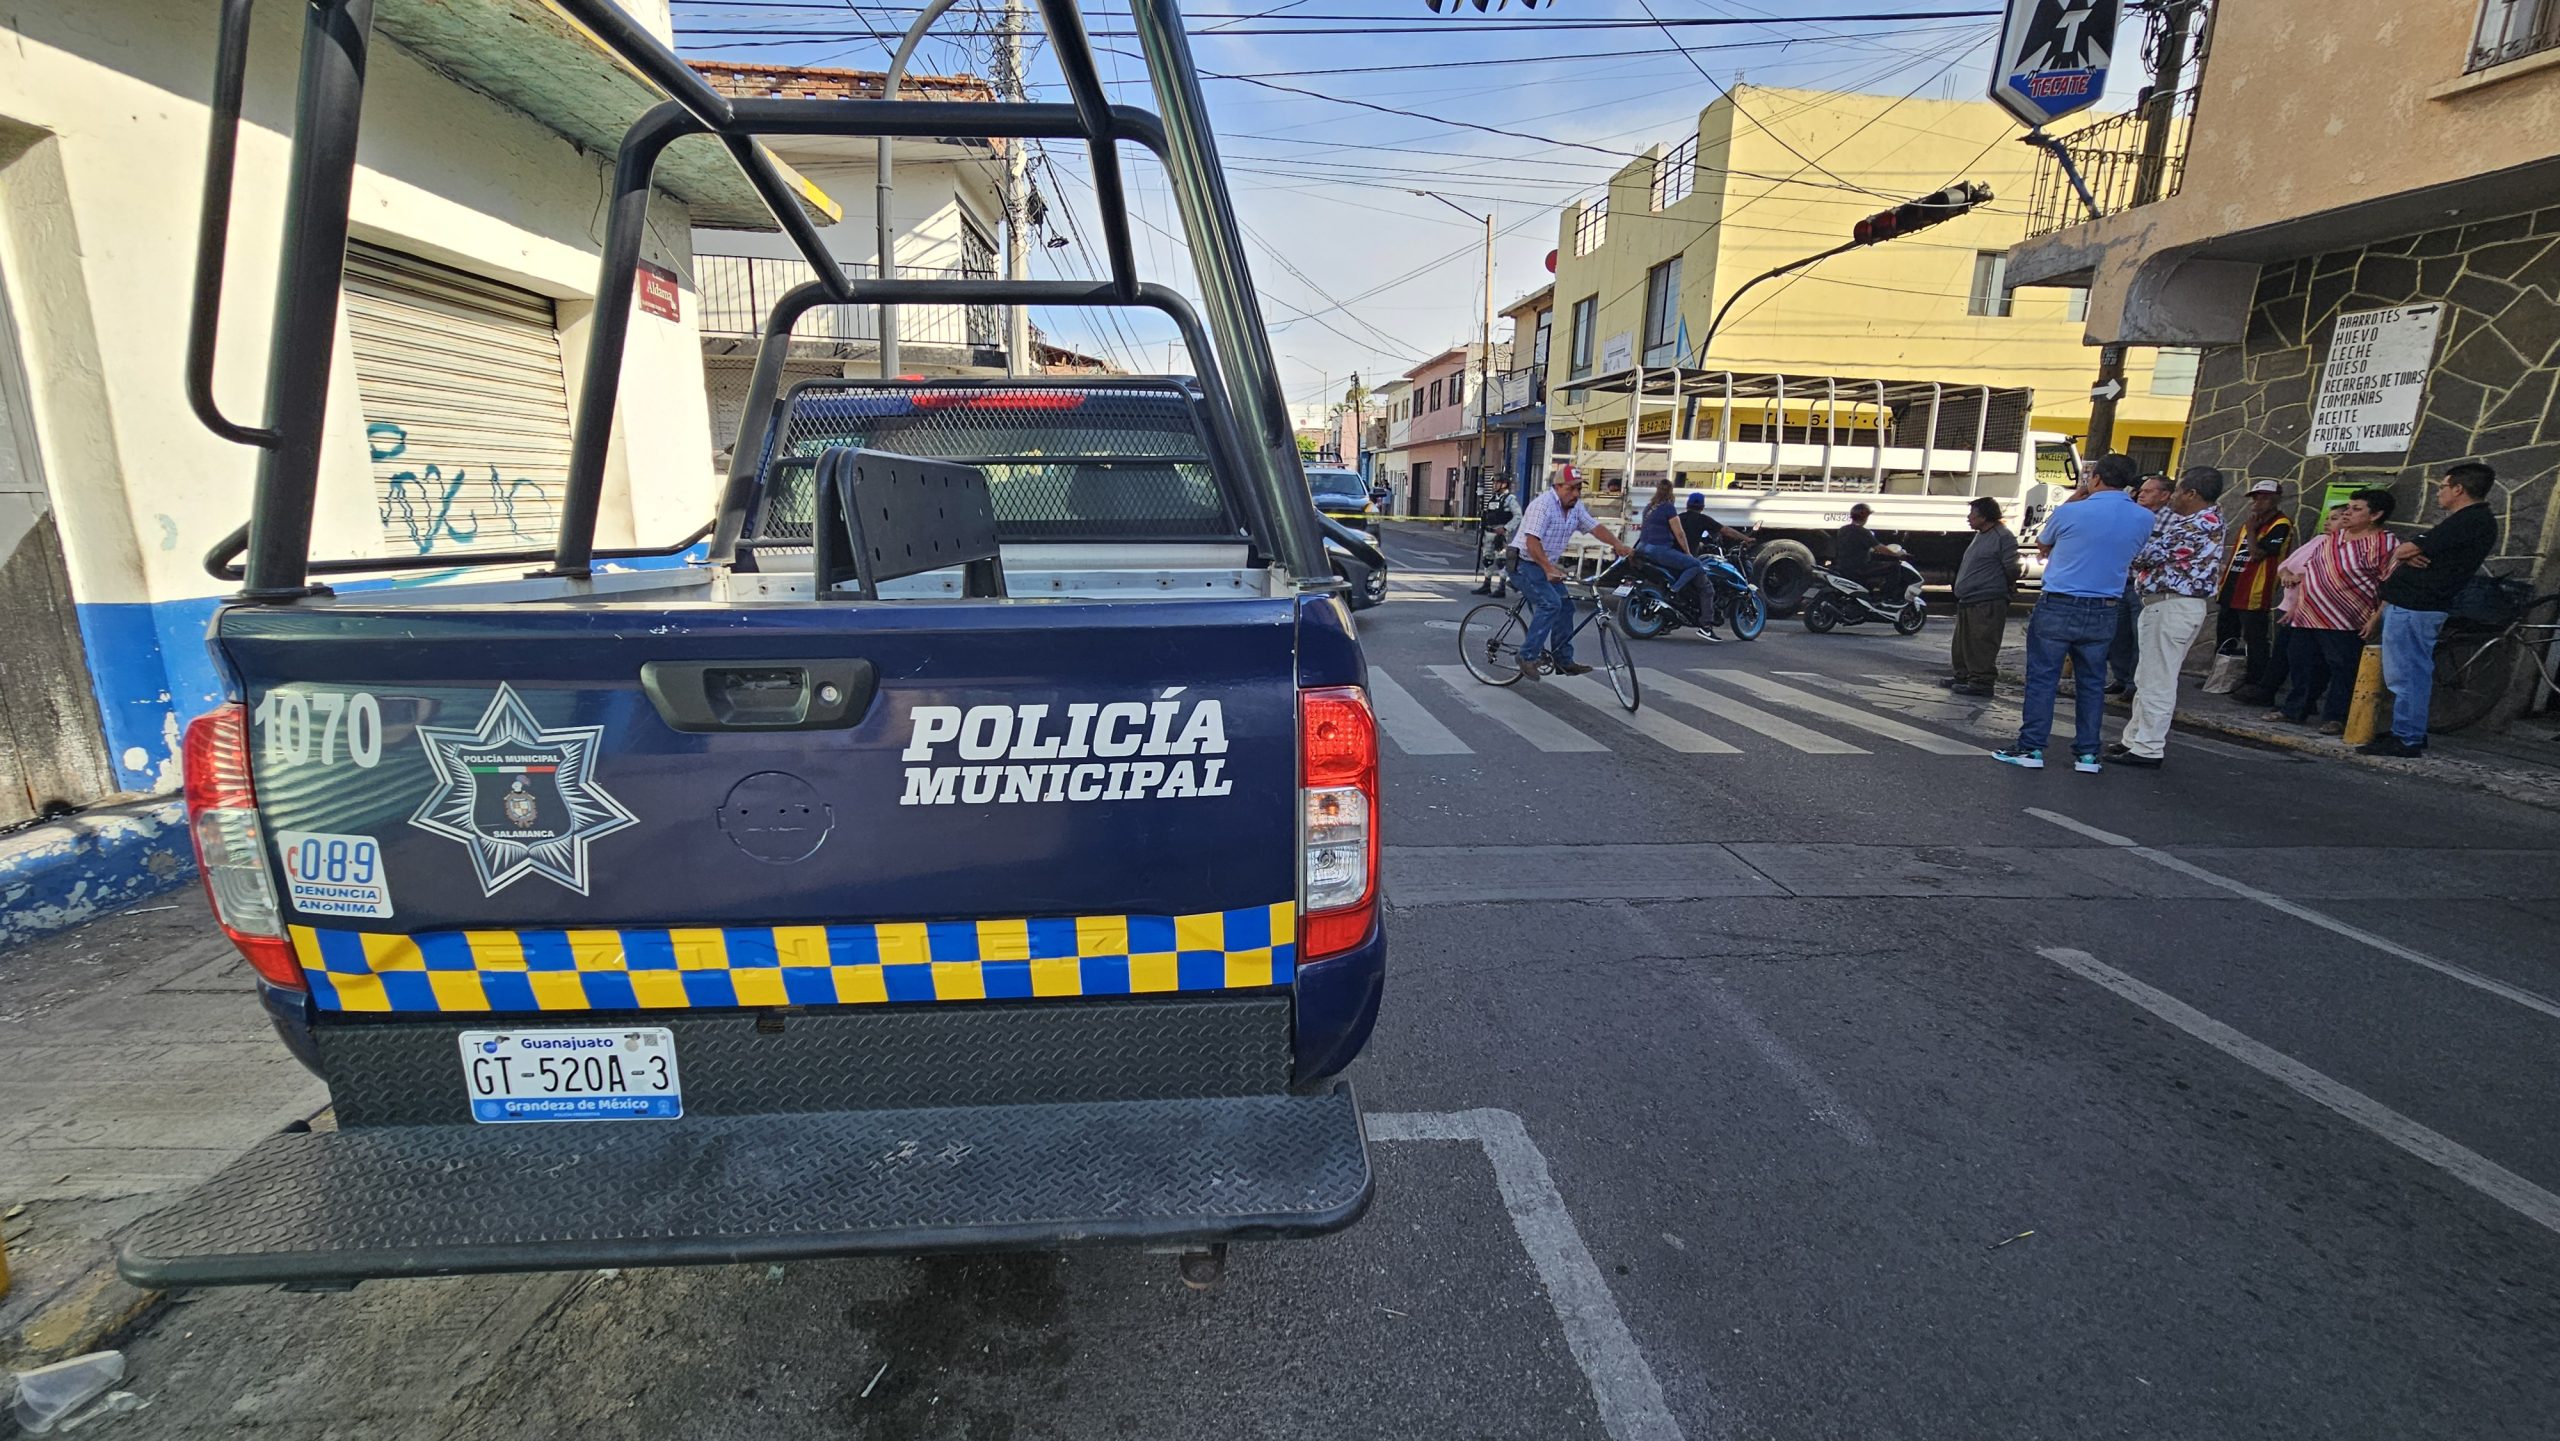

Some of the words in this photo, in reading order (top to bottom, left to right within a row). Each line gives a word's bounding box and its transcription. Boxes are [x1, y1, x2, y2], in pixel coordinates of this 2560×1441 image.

[2028, 74, 2092, 98] TECATE
[646, 280, 673, 301] Aldama
[2338, 309, 2400, 330] ABARROTES
[2334, 327, 2379, 346] HUEVO
[2331, 343, 2373, 362] LECHE
[2327, 360, 2368, 377] QUESO
[2324, 375, 2377, 394] RECARGAS
[2379, 373, 2391, 388] DE
[2393, 369, 2426, 386] TODAS
[2317, 409, 2359, 425] ACEITE
[2313, 425, 2353, 442] FRUTAS
[2356, 425, 2363, 440] Y
[2362, 421, 2413, 439] VERDURAS
[2324, 440, 2361, 453] FRIJOL
[255, 689, 382, 768] 1070
[902, 686, 1229, 762] POLICÍA
[463, 753, 504, 763] POLICÍA
[505, 754, 561, 763] MUNICIPAL
[900, 758, 1233, 806] MUNICIPAL
[493, 830, 555, 838] SALAMANCA
[295, 885, 378, 899] DENUNCIA
[520, 1036, 614, 1051] Guanajuato
[473, 1054, 670, 1096] GT-520A-3
[505, 1100, 575, 1112] Grandeza
[577, 1099, 596, 1110] de
[598, 1098, 650, 1110] México
